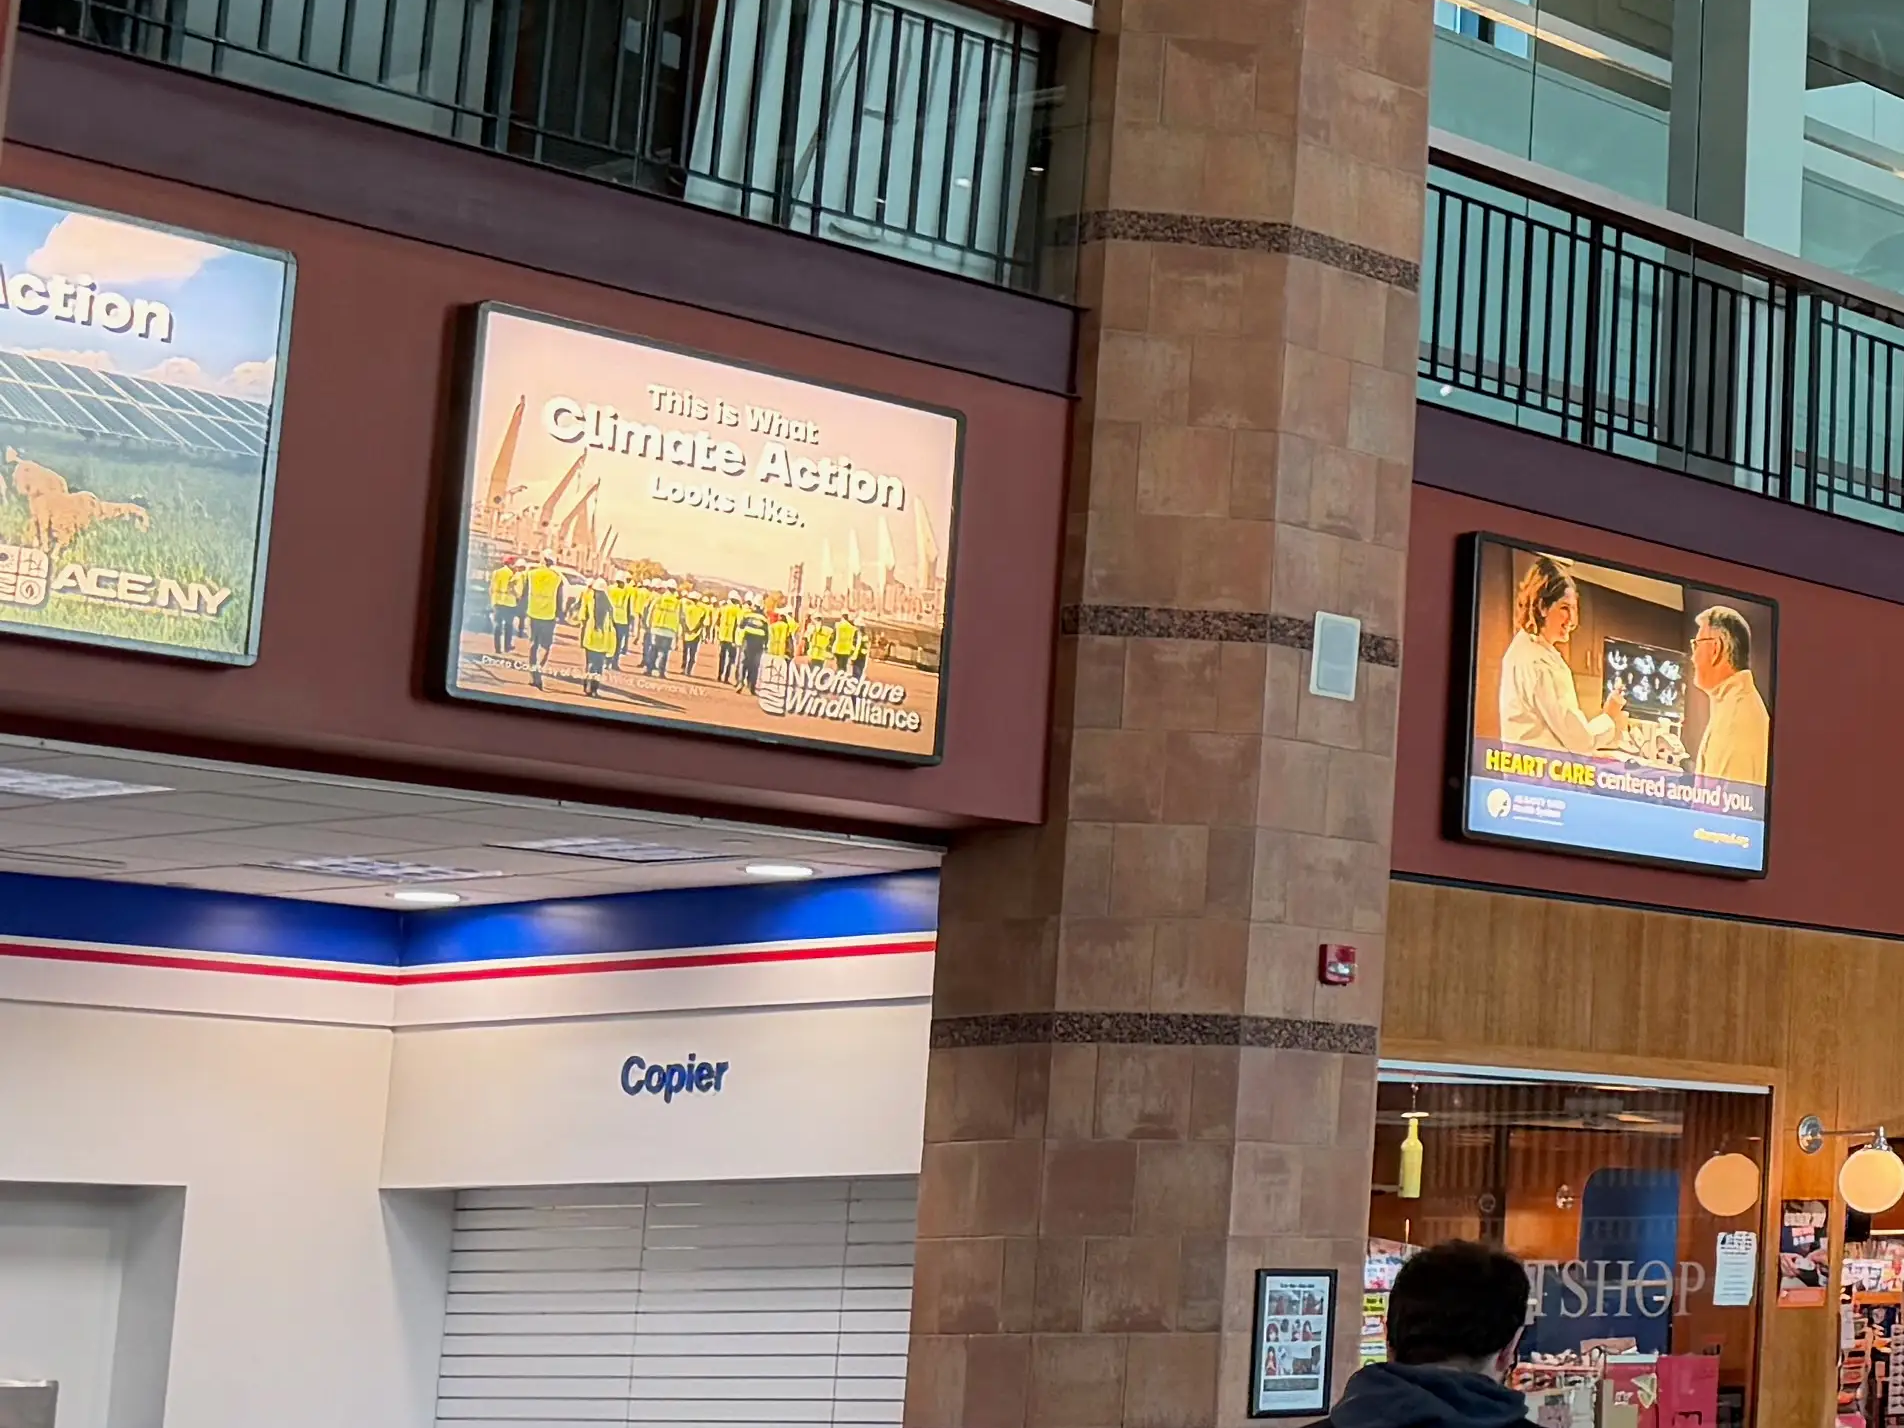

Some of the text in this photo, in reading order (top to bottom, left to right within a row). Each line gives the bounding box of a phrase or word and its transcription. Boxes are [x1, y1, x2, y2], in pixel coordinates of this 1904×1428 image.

[0, 268, 175, 345] ction
[645, 382, 820, 446] This is What
[541, 395, 907, 512] Climate Action
[650, 475, 806, 529] Looks Like.
[785, 685, 921, 732] WindAlliance
[787, 658, 906, 705] NYOffshore
[1486, 748, 1754, 814] HEART CARE centered around you.
[619, 1053, 730, 1106] Copier
